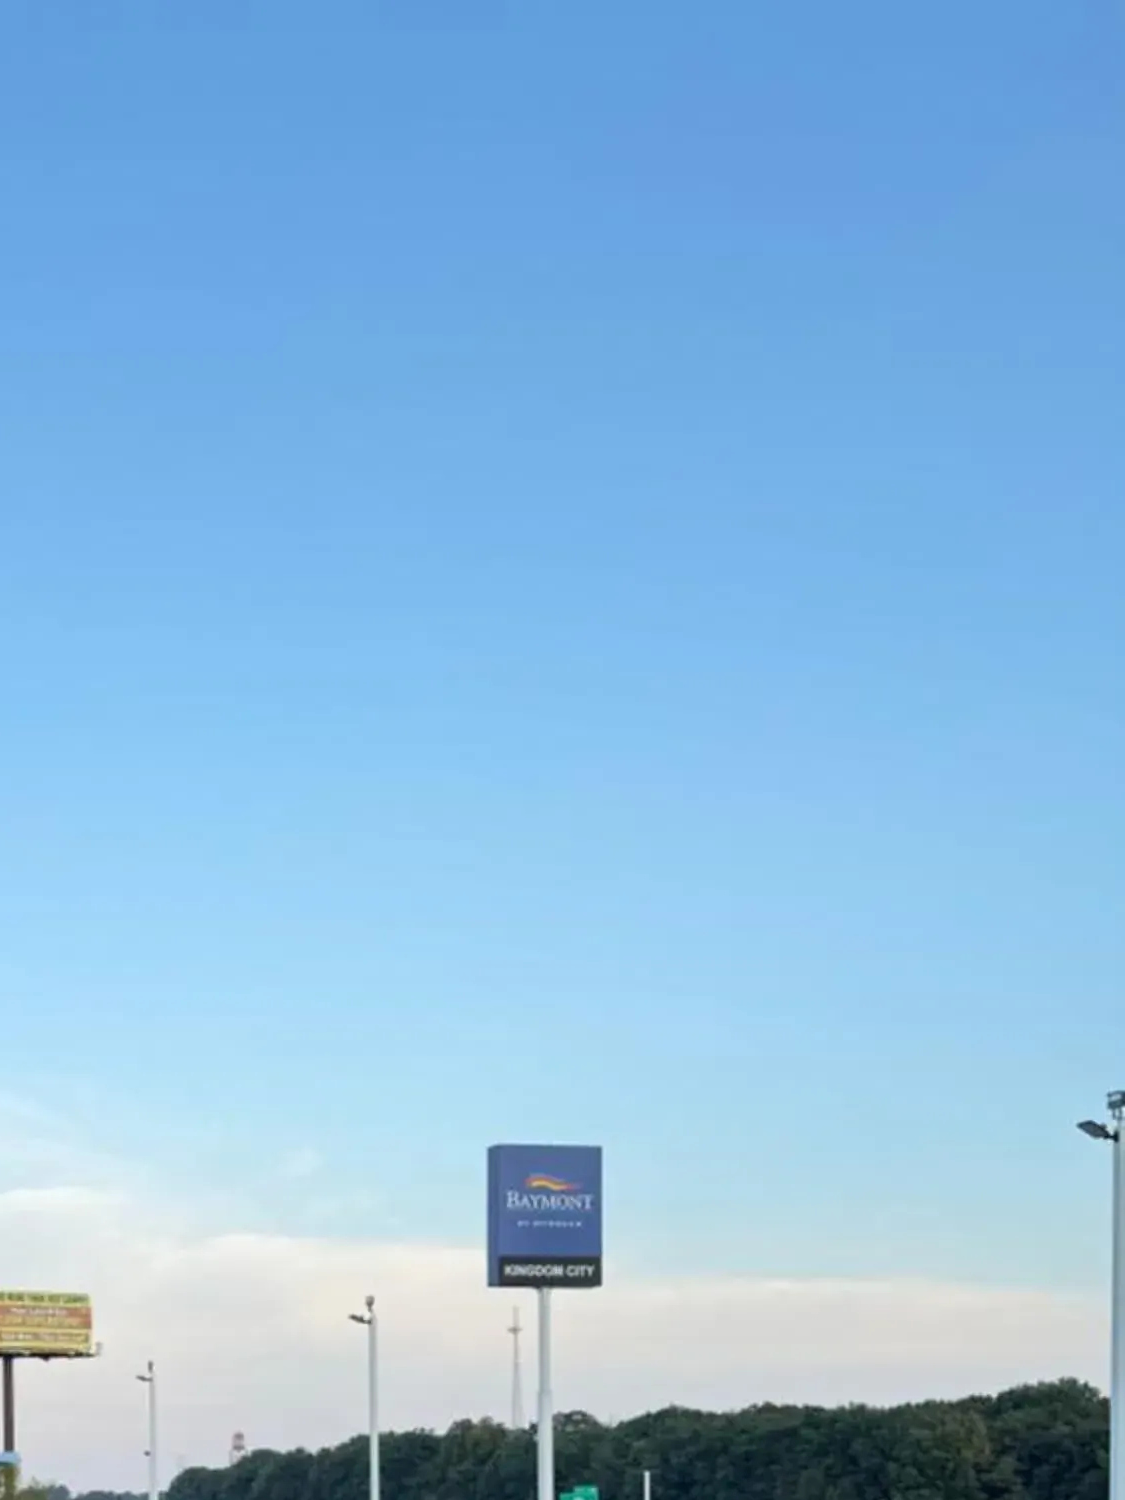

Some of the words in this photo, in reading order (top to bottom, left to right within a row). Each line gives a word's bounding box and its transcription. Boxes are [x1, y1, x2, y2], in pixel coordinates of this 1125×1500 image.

[506, 1190, 593, 1210] BAYMONT
[504, 1264, 563, 1277] KINGDOM
[566, 1264, 594, 1277] CITY
